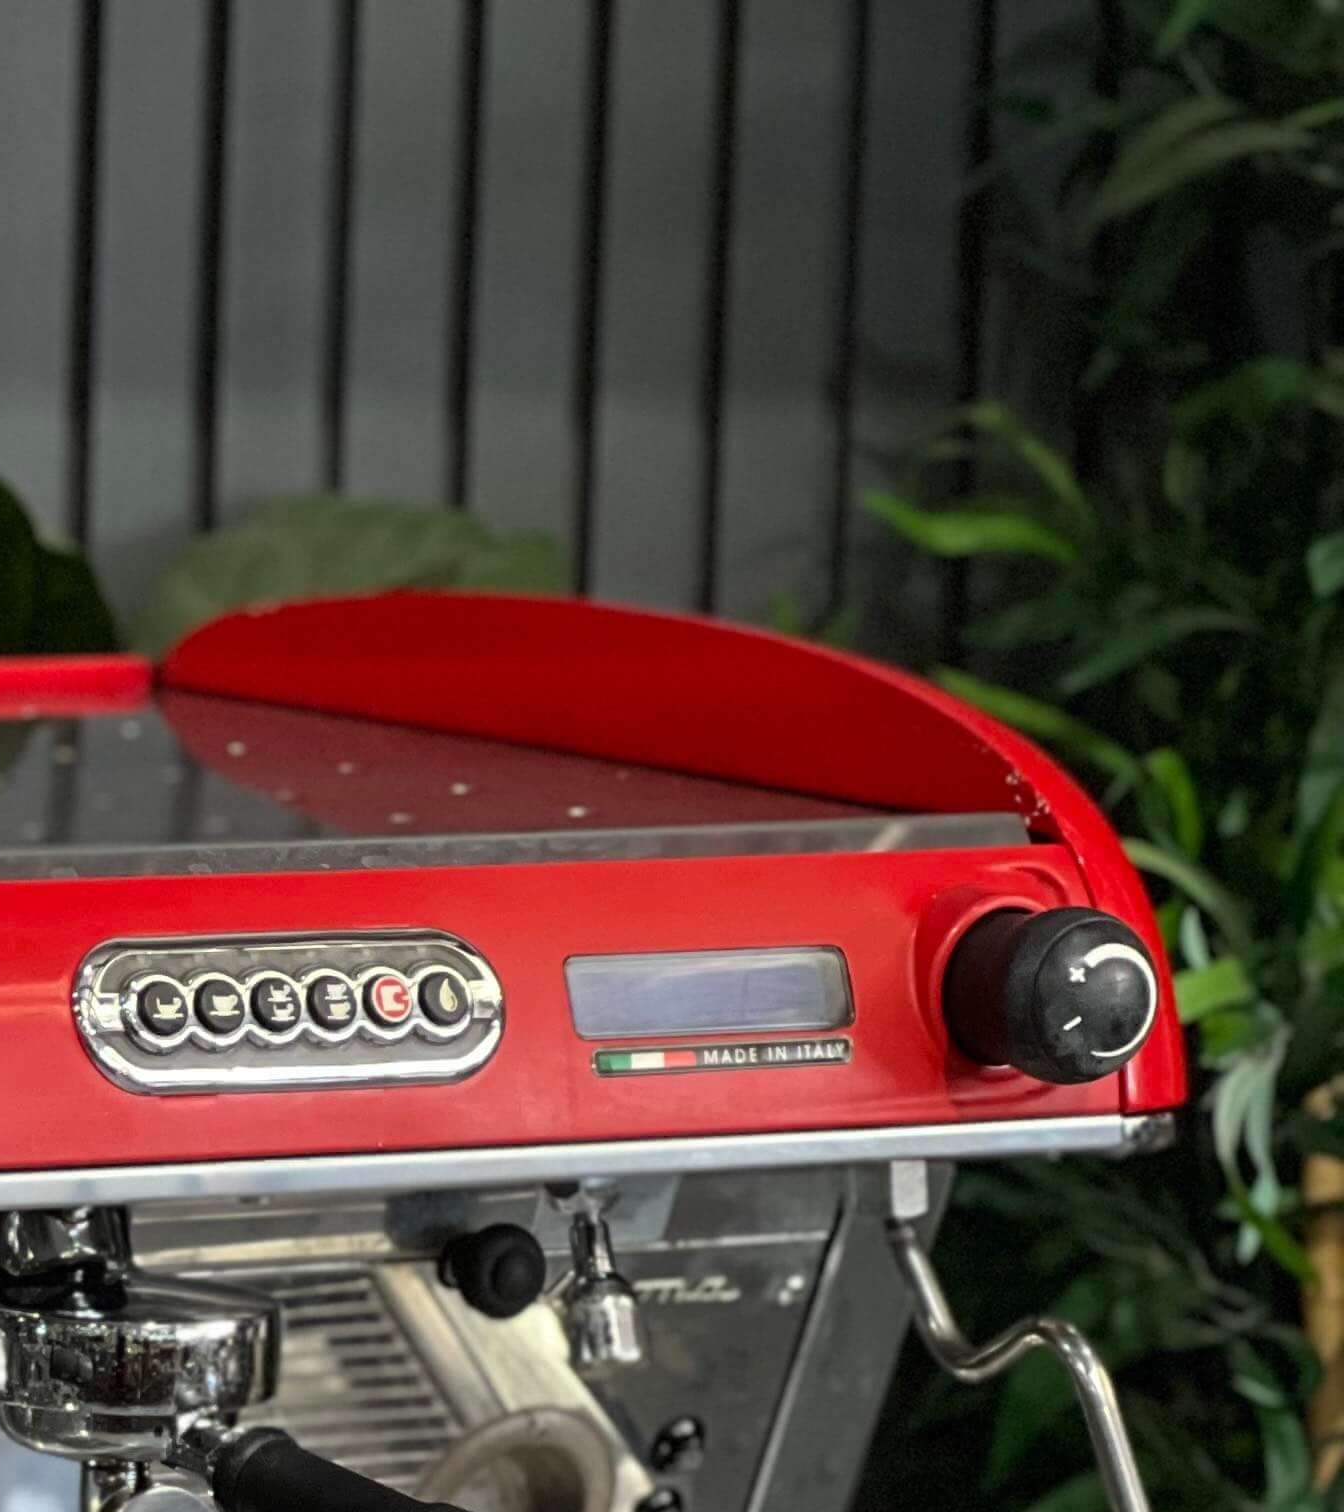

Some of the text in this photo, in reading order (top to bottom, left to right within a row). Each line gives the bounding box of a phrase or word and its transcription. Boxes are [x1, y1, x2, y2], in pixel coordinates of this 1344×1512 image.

[703, 1042, 845, 1065] MADE IN ITALY
